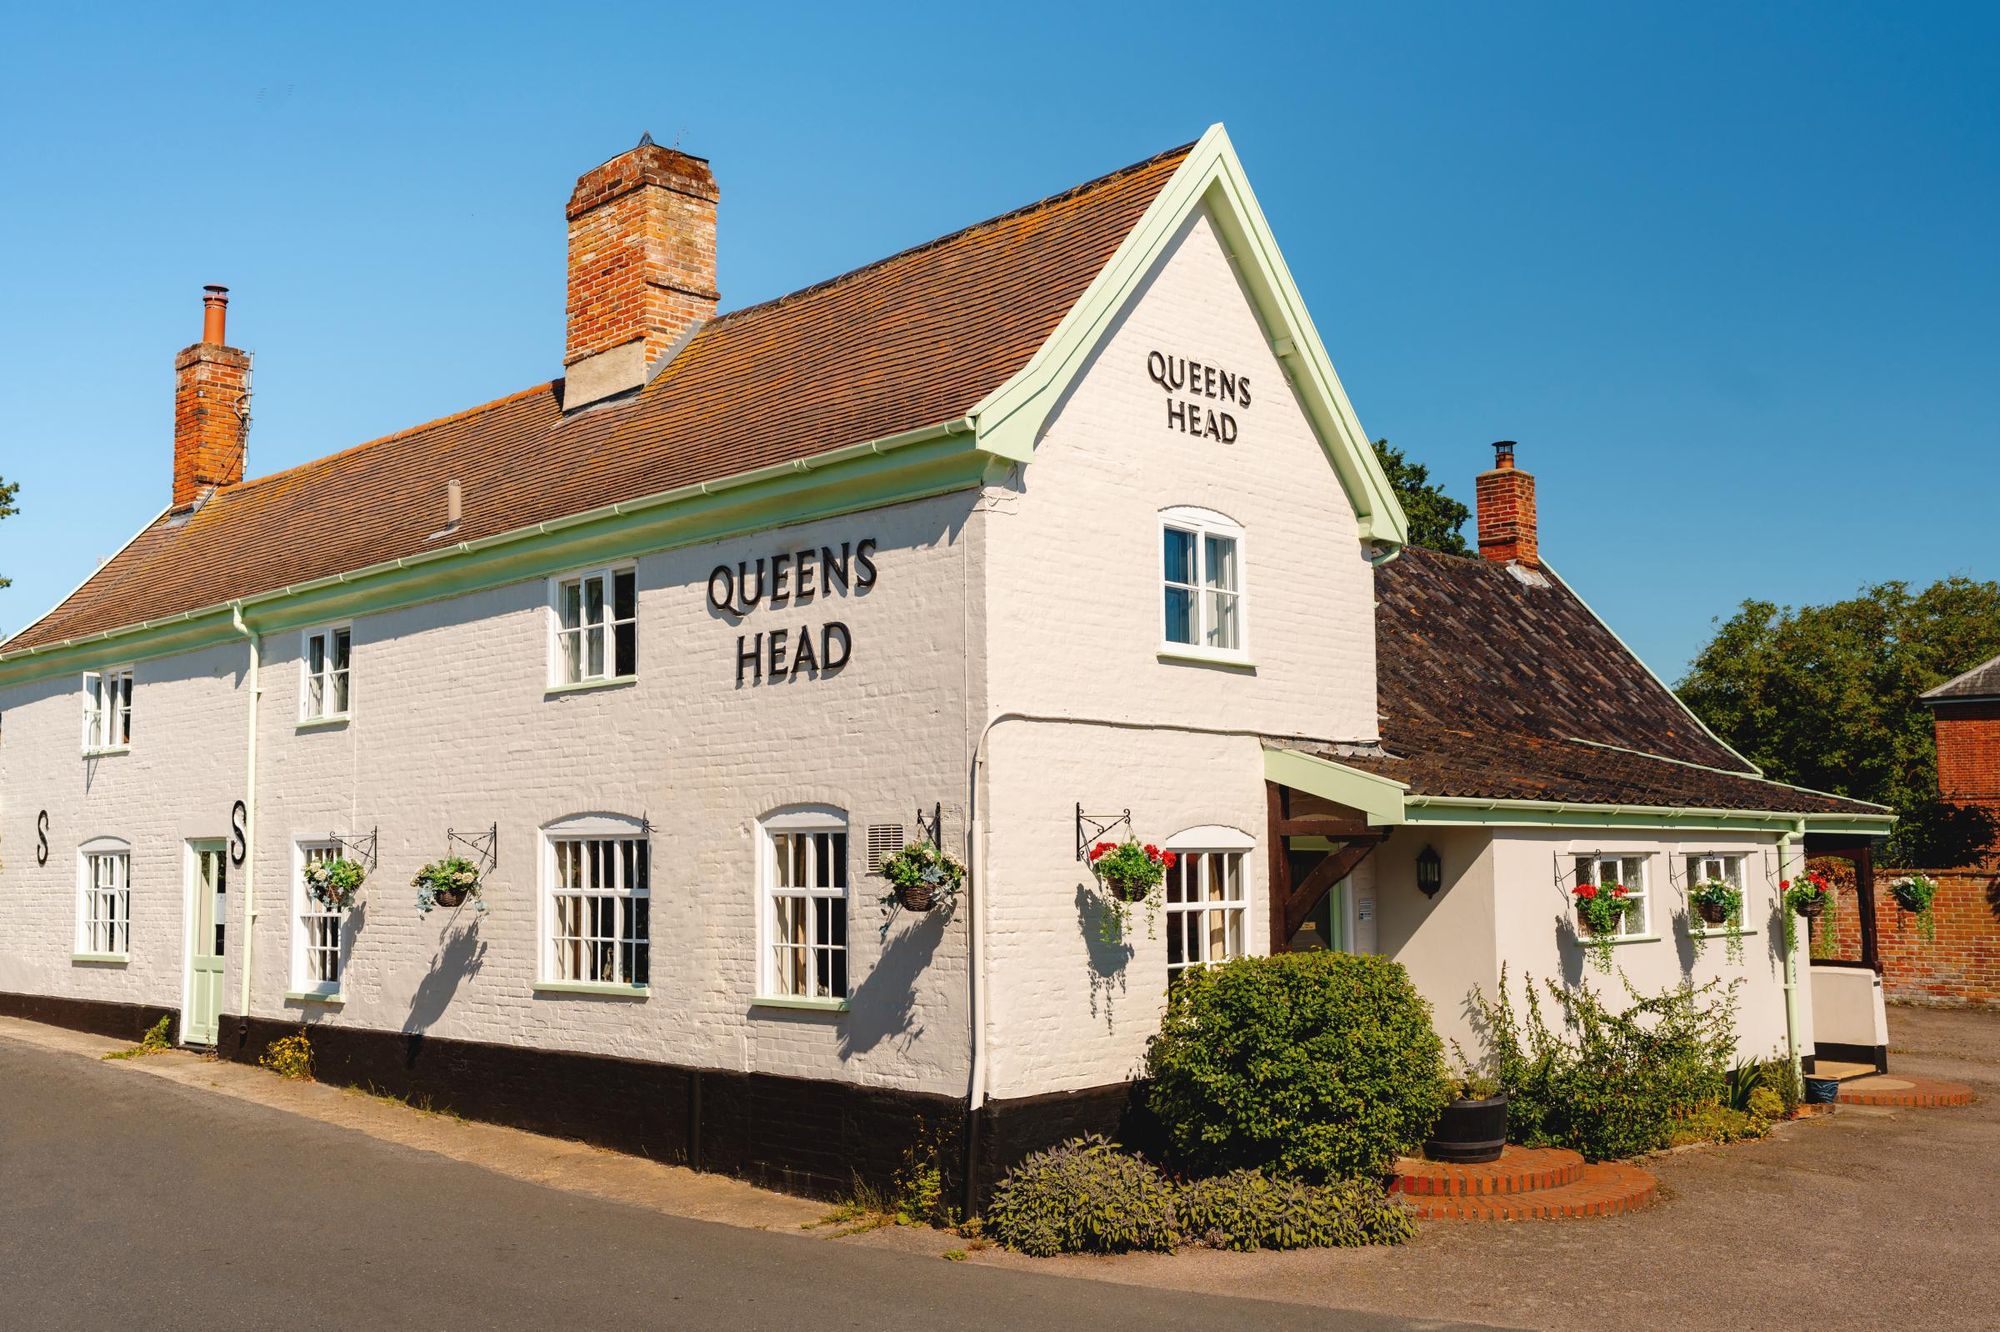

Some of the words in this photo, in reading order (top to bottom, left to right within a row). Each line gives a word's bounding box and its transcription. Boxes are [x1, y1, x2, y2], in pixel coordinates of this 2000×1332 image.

[1147, 350, 1252, 407] QUEENS
[1167, 397, 1238, 443] HEAD
[708, 537, 878, 617] QUEENS
[736, 621, 852, 681] HEAD
